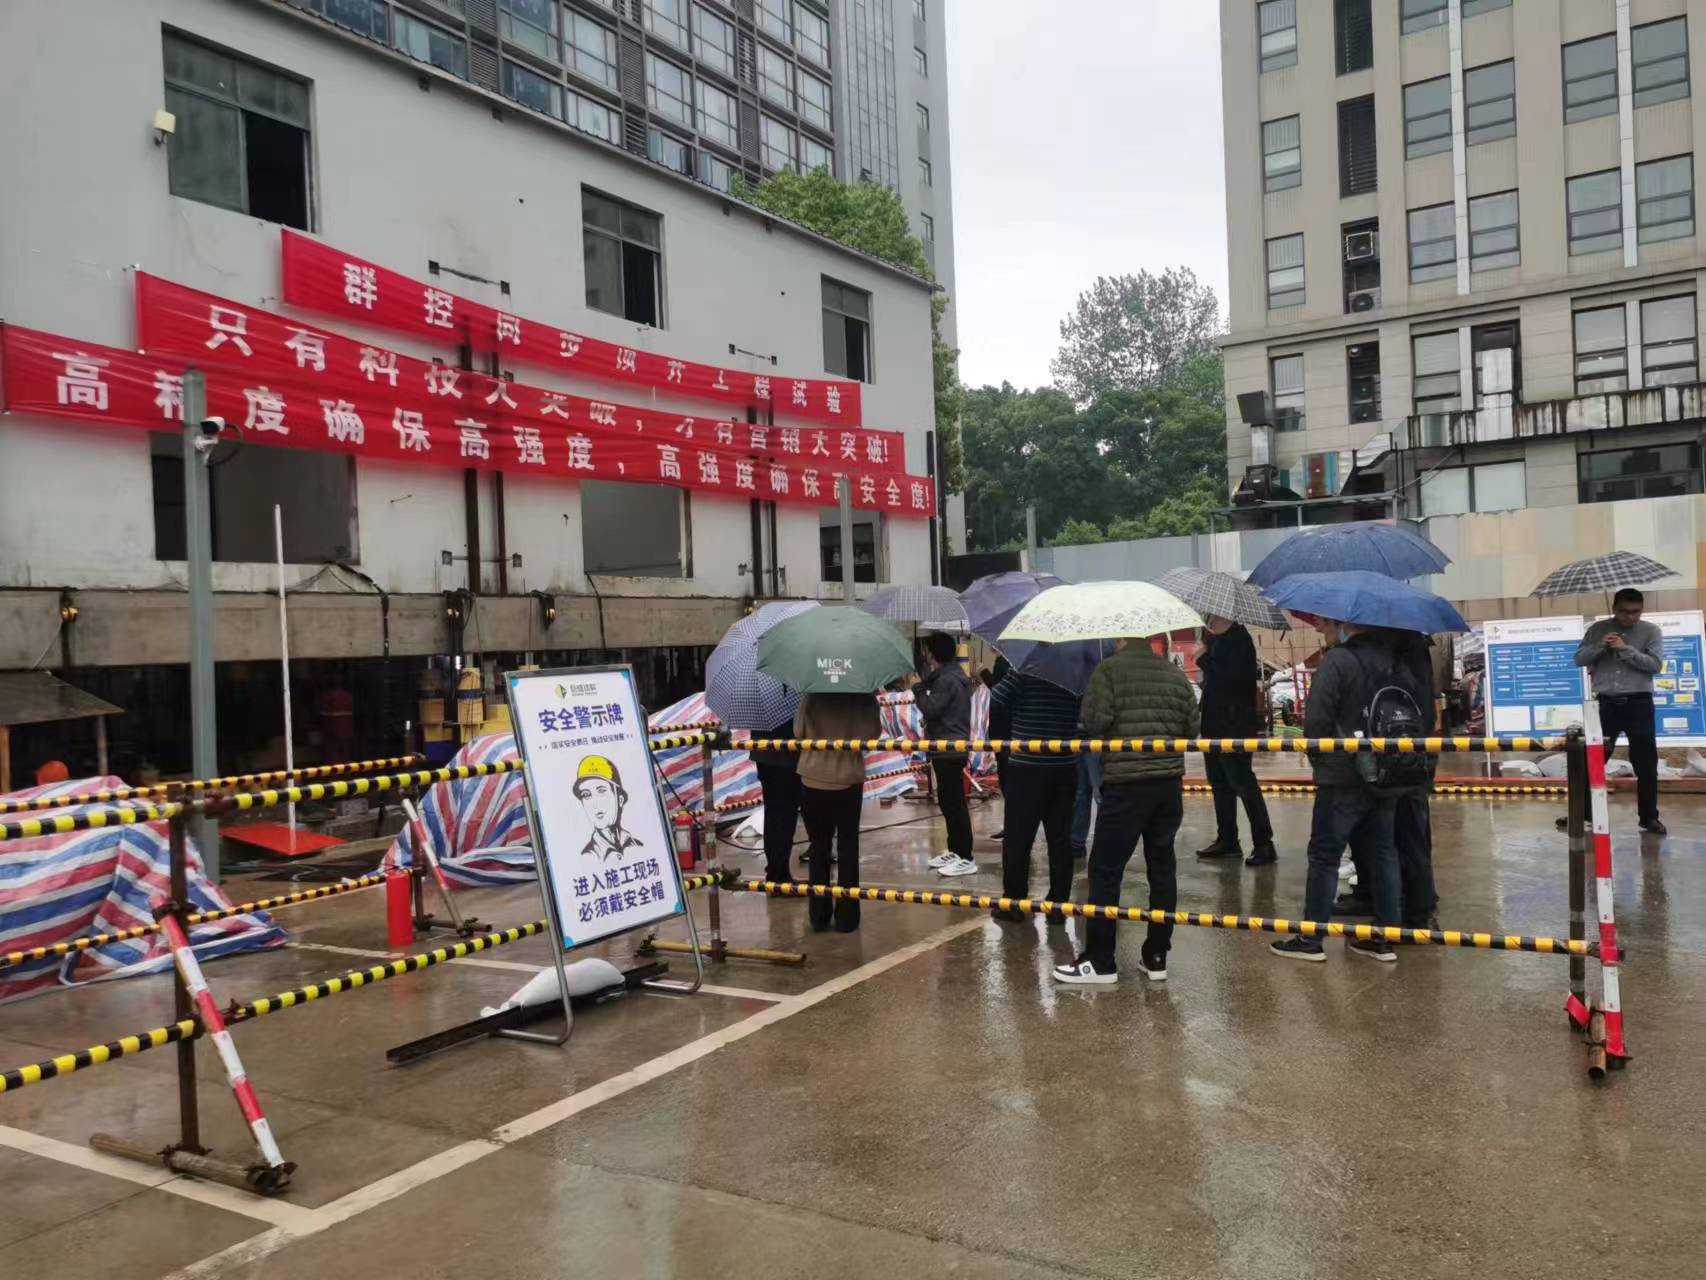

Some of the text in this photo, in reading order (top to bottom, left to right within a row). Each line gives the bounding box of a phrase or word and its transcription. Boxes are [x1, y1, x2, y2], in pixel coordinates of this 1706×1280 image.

[816, 657, 853, 669] MICK
[538, 702, 624, 734] 安全警示牌
[573, 857, 660, 898] 进入施工现场
[578, 880, 665, 923] 必须戴安全帽
